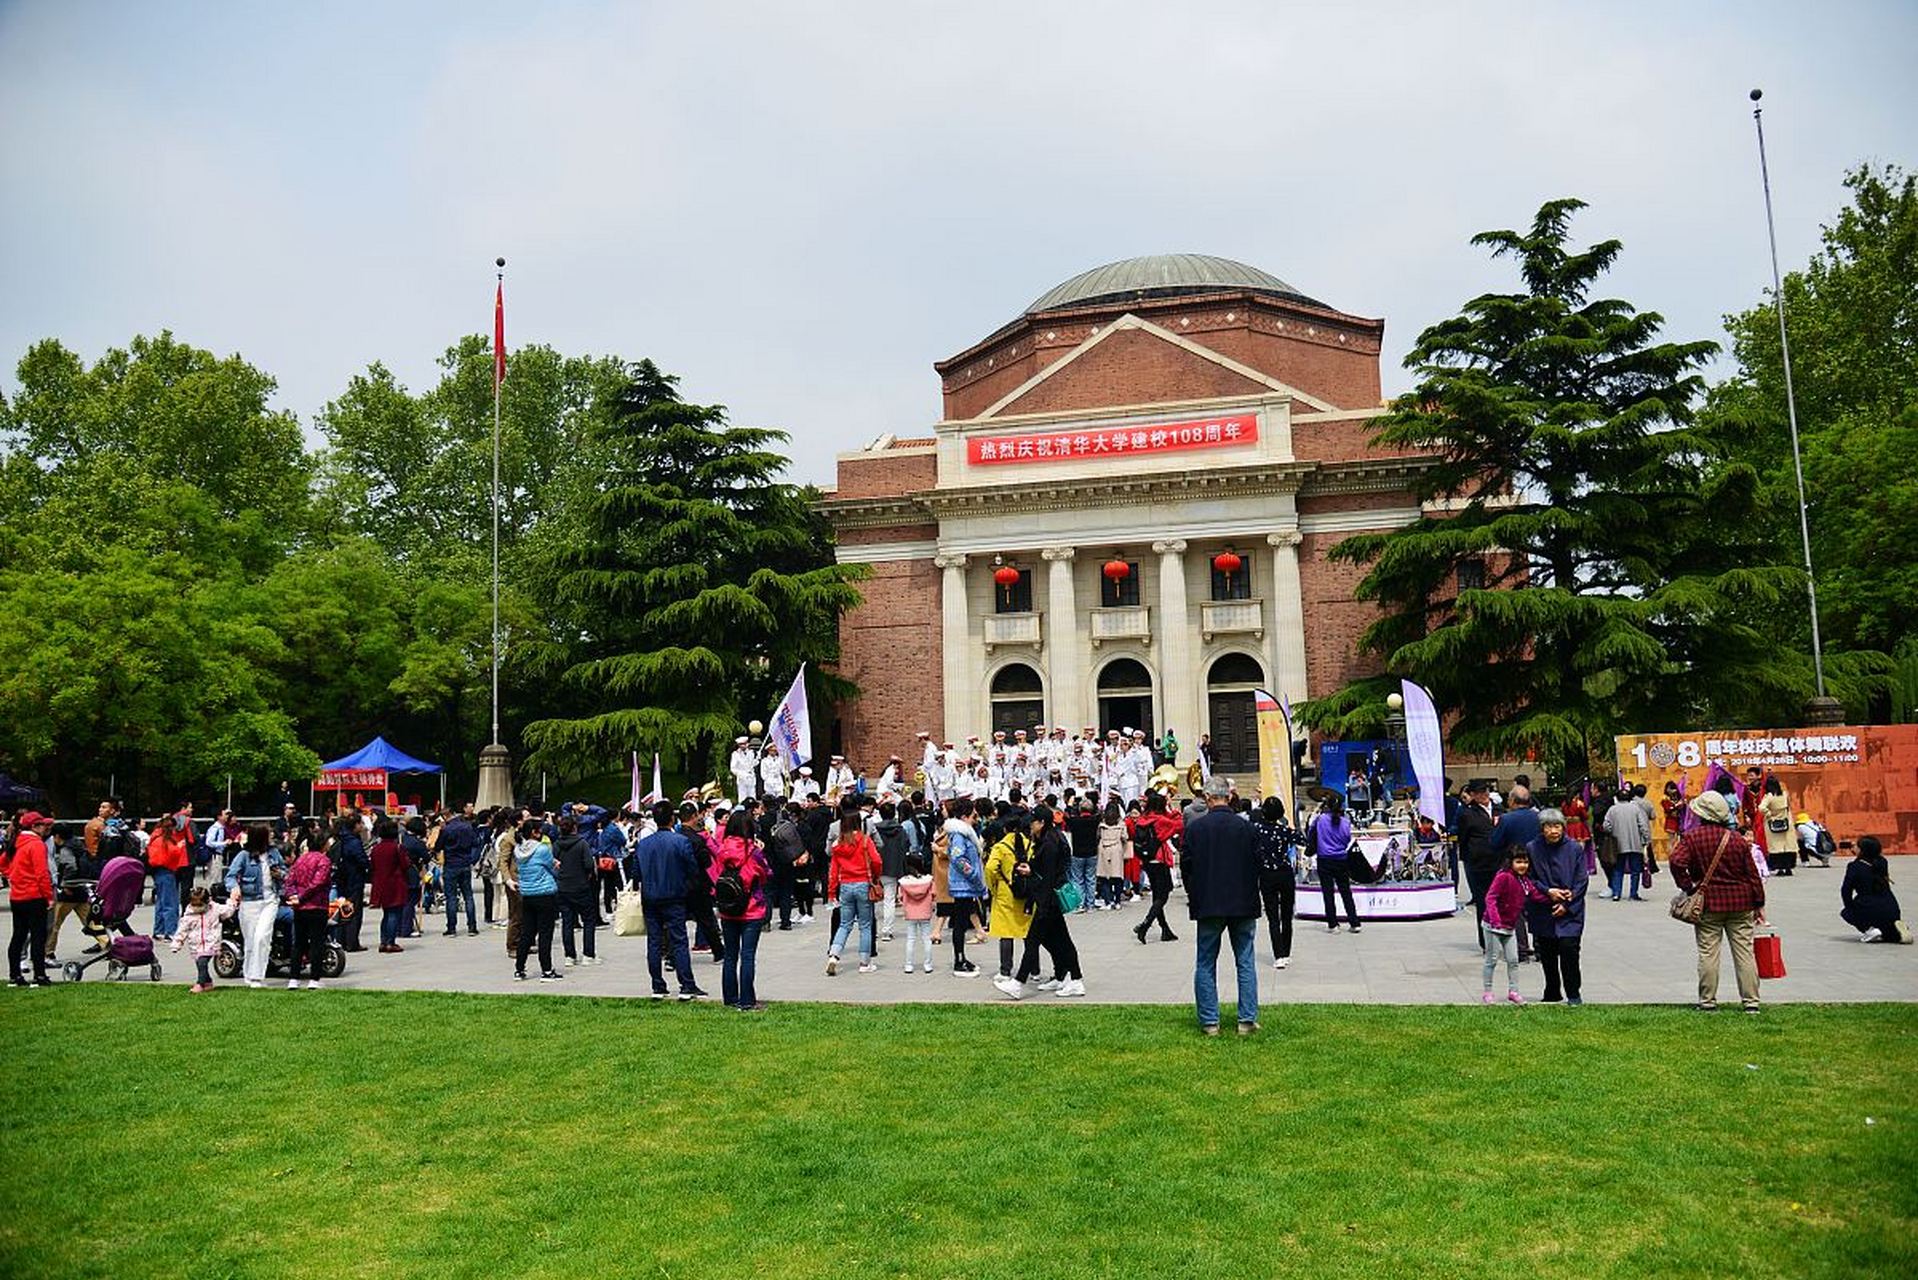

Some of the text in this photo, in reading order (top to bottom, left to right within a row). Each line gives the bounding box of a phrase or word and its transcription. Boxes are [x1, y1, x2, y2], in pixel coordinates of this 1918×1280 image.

[980, 423, 1242, 459] 热烈庆祝清华大学建校108周年
[1705, 735, 1858, 755] 周年校庆集体舞联欢
